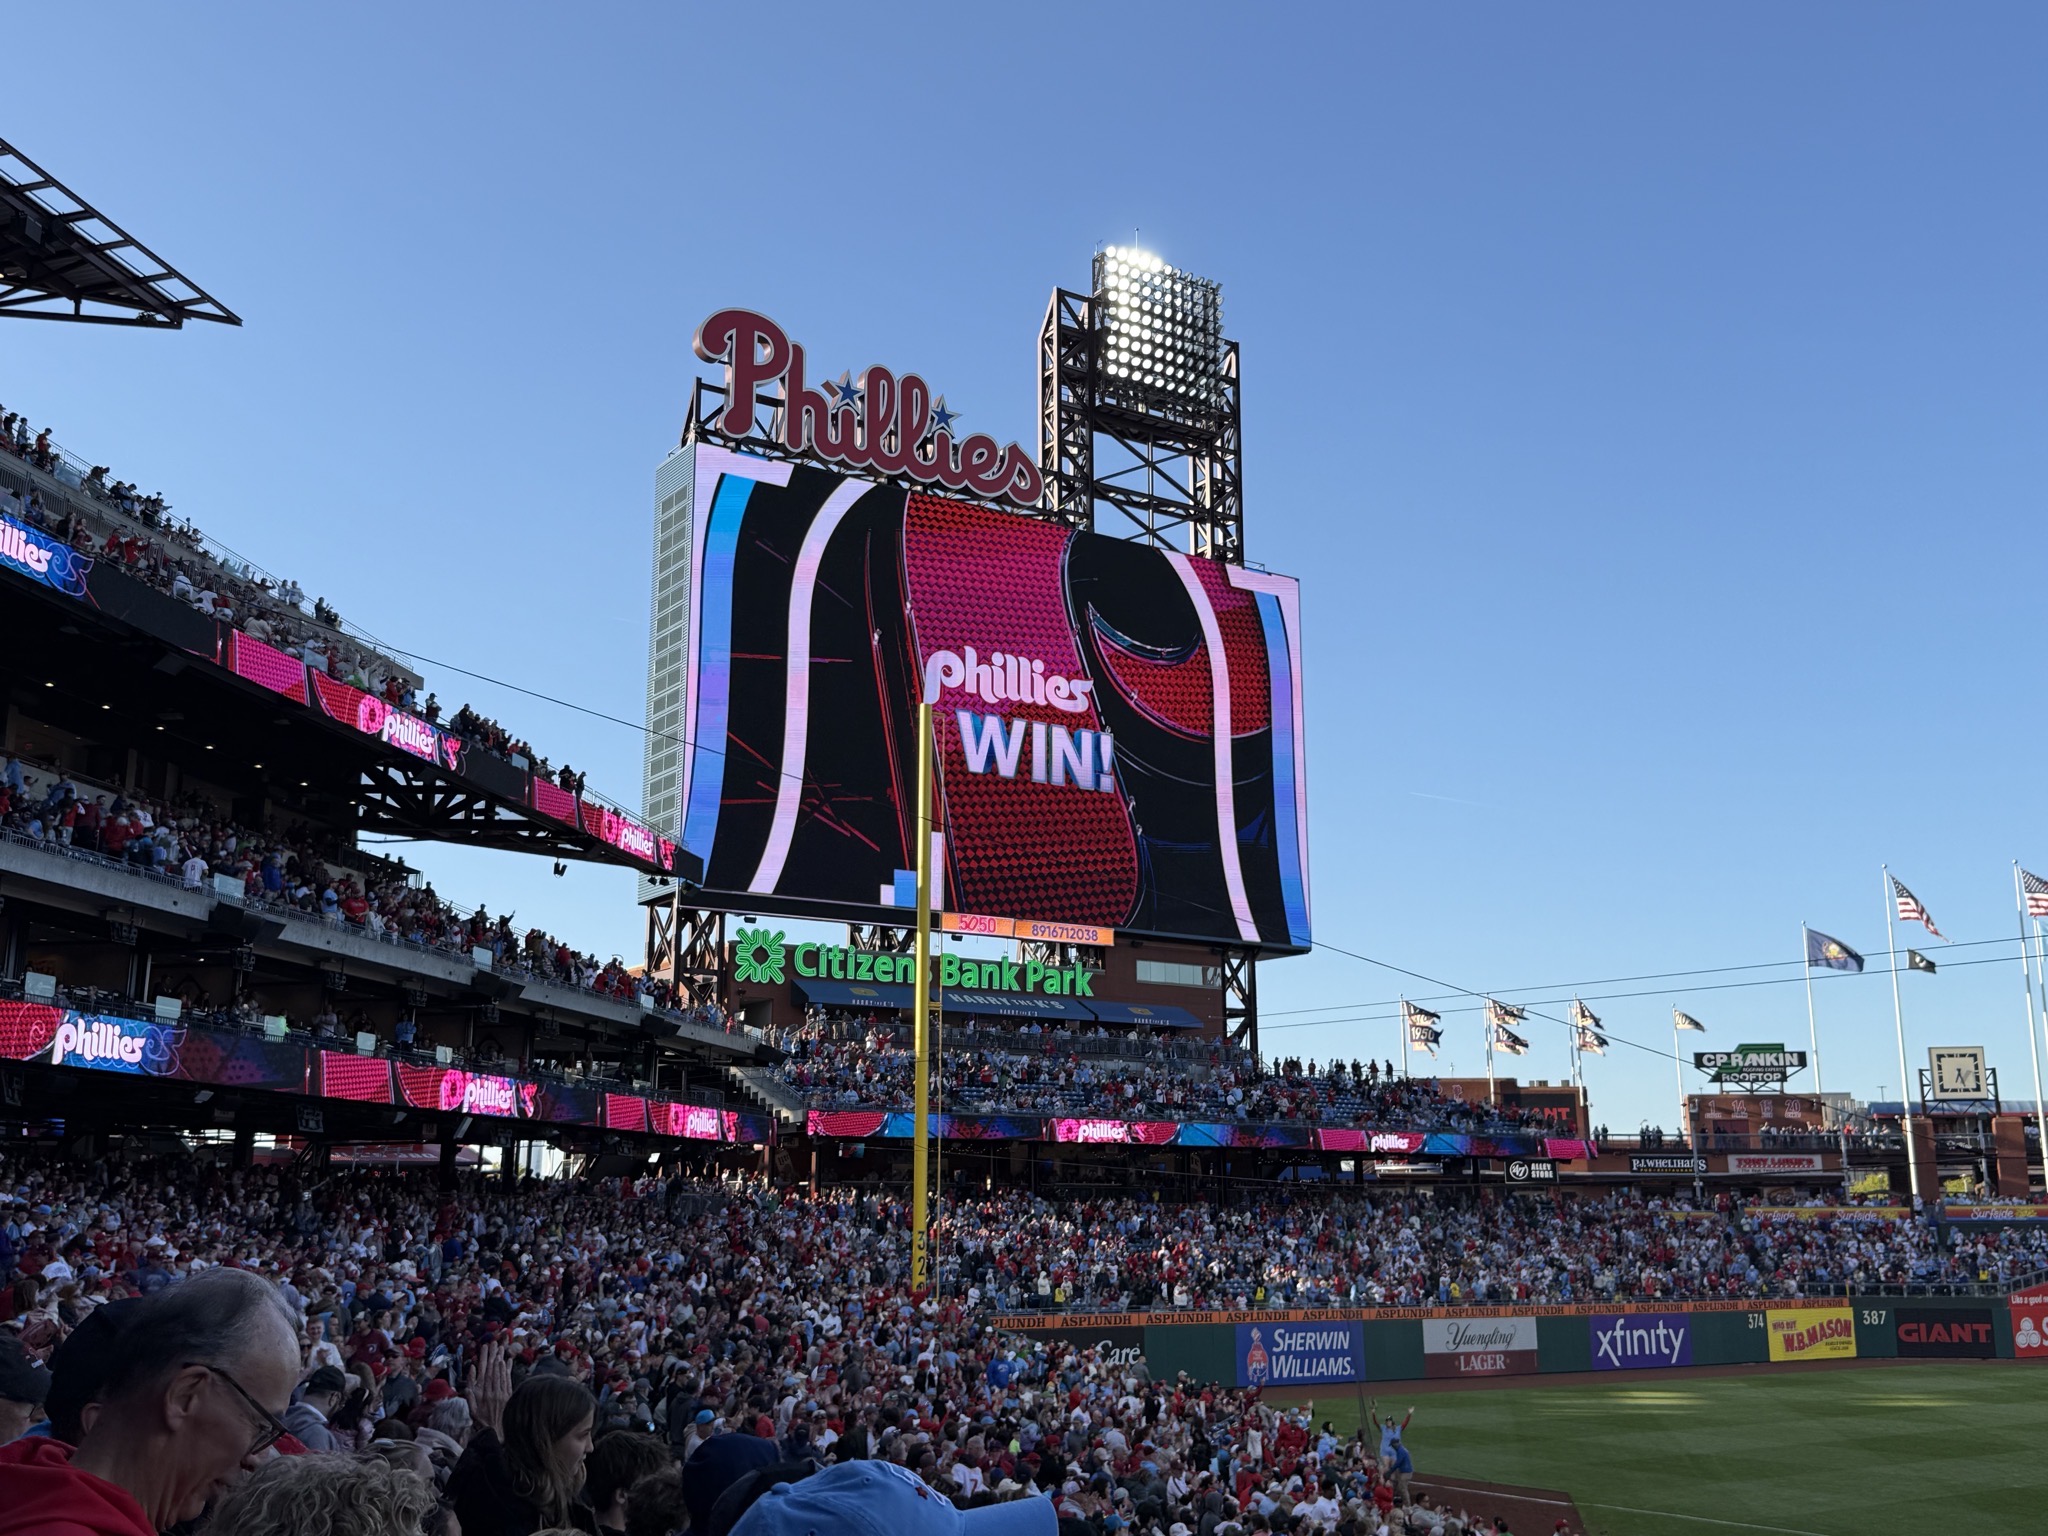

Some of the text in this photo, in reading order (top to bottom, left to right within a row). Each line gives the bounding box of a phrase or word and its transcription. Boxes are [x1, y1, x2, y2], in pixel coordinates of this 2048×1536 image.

[693, 308, 1044, 506] Phillies
[923, 646, 1093, 713] phillies
[956, 709, 1114, 793] WIN!
[1032, 924, 1098, 941] 8916712038
[794, 942, 1094, 997] Citizen Bank Park
[948, 993, 1012, 1006] HARRY
[1411, 1027, 1435, 1040] 1950
[52, 1018, 146, 1065] phillies
[1702, 1053, 1799, 1067] CP RANKIN
[1722, 1073, 1782, 1082] ROOFTOP
[1971, 1207, 2013, 1220] Surfside
[1575, 1305, 1625, 1314] ASPLUNDH
[1635, 1304, 1683, 1312] ASPLUNDH
[1693, 1302, 1739, 1311] ASPLUNDH
[1747, 1300, 1792, 1309] ASPLUNDH
[1801, 1299, 1843, 1308] ASPLUNDH
[1226, 1311, 1290, 1322] ASPLUNDH
[1302, 1309, 1363, 1320] ASPLUNDH
[1375, 1308, 1433, 1319] ASPLUNDH
[1444, 1307, 1500, 1317] ASPLUNDH
[1511, 1306, 1564, 1315] ASPLUNDH
[992, 1317, 1046, 1328] PLUNDH
[1061, 1314, 1132, 1327] ASPLUNDH
[1146, 1312, 1213, 1324] ASPLUNDH
[1748, 1313, 1764, 1329] 374
[1862, 1310, 1886, 1325] 387
[1445, 1322, 1517, 1351] Yuengling
[1898, 1323, 1992, 1343] GIANT
[1272, 1328, 1350, 1352] SHERWIN
[1597, 1318, 1685, 1367] xfinity
[1460, 1354, 1506, 1371] LAGER
